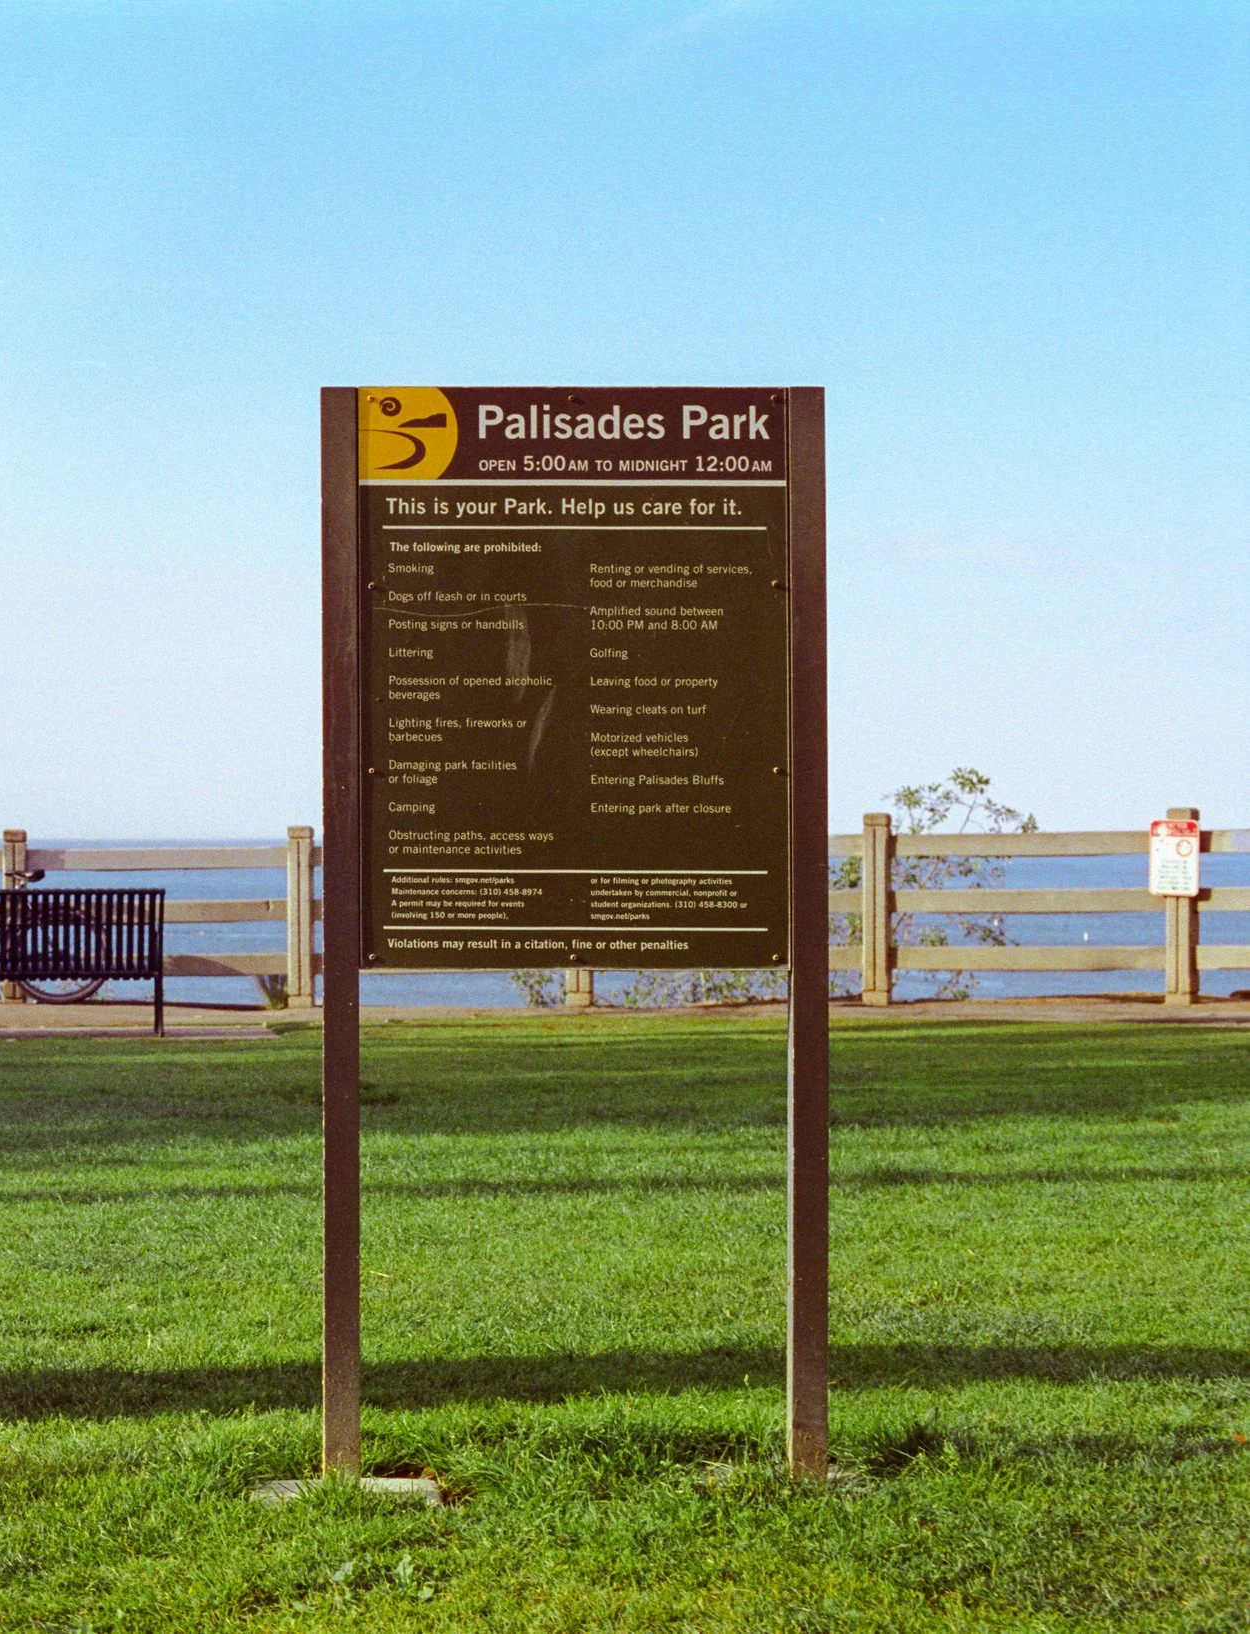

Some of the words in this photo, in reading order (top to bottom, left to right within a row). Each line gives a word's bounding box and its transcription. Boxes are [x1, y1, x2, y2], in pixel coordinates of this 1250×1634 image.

[478, 404, 665, 440] Palisades
[682, 405, 770, 440] Park
[479, 459, 516, 471] OPEN
[595, 460, 612, 472] TO
[619, 460, 688, 472] MIDNIGHT
[386, 498, 426, 514] This
[434, 497, 449, 514] is
[456, 502, 497, 518] your
[505, 498, 552, 514] Park.
[562, 498, 606, 518] Help
[614, 502, 634, 515] us
[642, 502, 682, 515] care
[689, 498, 715, 515] for
[723, 498, 742, 515] it.
[390, 542, 410, 552] The
[412, 542, 461, 554] following
[464, 544, 480, 552] are
[484, 542, 541, 554] prohibited:
[388, 563, 434, 575] Smoking
[590, 563, 631, 576] Renting
[634, 566, 645, 574] or
[648, 564, 690, 576] vending
[693, 564, 703, 574] of
[590, 577, 612, 588] food
[616, 580, 626, 588] or
[630, 578, 698, 588] merchandise
[388, 591, 414, 603] Dogs
[417, 591, 432, 601] off
[435, 591, 462, 601] leash
[466, 593, 477, 601] or
[481, 593, 490, 601] in
[494, 592, 527, 602] courts
[590, 606, 641, 618] Amplified
[645, 607, 676, 616] sound
[680, 606, 723, 616] between
[388, 619, 428, 632] Posting
[431, 621, 458, 631] signs
[461, 621, 472, 629] or
[476, 619, 525, 630] handbills
[592, 619, 623, 630] 10:00
[627, 620, 644, 629] PM
[648, 620, 667, 630] and
[671, 620, 697, 630] 8:00
[700, 620, 718, 630] AM
[389, 647, 434, 660] Littering
[590, 648, 628, 660] Golfing
[389, 675, 446, 686] Possession
[449, 675, 459, 686] of
[463, 676, 501, 687] opened
[505, 675, 552, 686] alcoholic
[590, 676, 631, 688] Leaving
[634, 676, 657, 686] food
[660, 678, 671, 686] or
[675, 677, 718, 688] property
[389, 690, 440, 702] beverages
[590, 704, 632, 716] Wearing
[635, 705, 667, 714] cleats
[670, 706, 683, 714] on
[687, 704, 706, 714] turf
[389, 717, 432, 730] Lighting
[435, 717, 462, 728] fires,
[466, 717, 513, 728] fireworks
[516, 720, 526, 728] or
[389, 732, 442, 742] barbecues
[591, 732, 642, 743] Motorized
[646, 733, 688, 742] vehicles
[590, 746, 628, 758] (except
[632, 747, 698, 757] wheelchairs)
[389, 759, 441, 772] Damaging
[444, 760, 467, 771] park
[471, 760, 517, 770] facilities
[388, 776, 398, 784] or
[402, 773, 438, 786] foliage
[591, 774, 635, 787] Entering
[639, 775, 689, 785] Palisades
[692, 775, 724, 785] Bluffs
[388, 801, 435, 814] Camping
[591, 802, 635, 815] Entering
[639, 804, 661, 815] park
[665, 803, 689, 813] after
[693, 804, 731, 814] closure
[388, 830, 450, 842] Obstructing
[454, 831, 486, 842] paths,
[490, 832, 525, 840] access
[528, 833, 554, 842] ways
[388, 846, 399, 854] or
[402, 844, 470, 854] maintenance
[474, 845, 522, 854] activities
[391, 876, 429, 884] Additional
[455, 877, 514, 885] smgov.net/parks
[613, 877, 639, 886] filming
[651, 877, 696, 886] photography
[391, 887, 439, 895] Maintenance
[479, 888, 501, 896] (310)
[503, 888, 542, 896] 458-8974
[634, 889, 643, 897] by
[693, 889, 728, 898] nonprofit
[399, 900, 423, 908] permit
[455, 900, 486, 908] required
[620, 901, 672, 909] organizations.
[391, 911, 428, 920] (involving
[430, 911, 445, 919] 150
[590, 913, 650, 921] smgov.net/parks
[387, 938, 439, 948] Violations
[442, 941, 464, 950] may
[467, 939, 497, 949] result
[501, 939, 511, 948] in
[515, 941, 521, 949] a
[524, 939, 568, 950] citation,
[572, 939, 592, 949] fine
[609, 940, 637, 950] other
[641, 940, 688, 952] penalties
